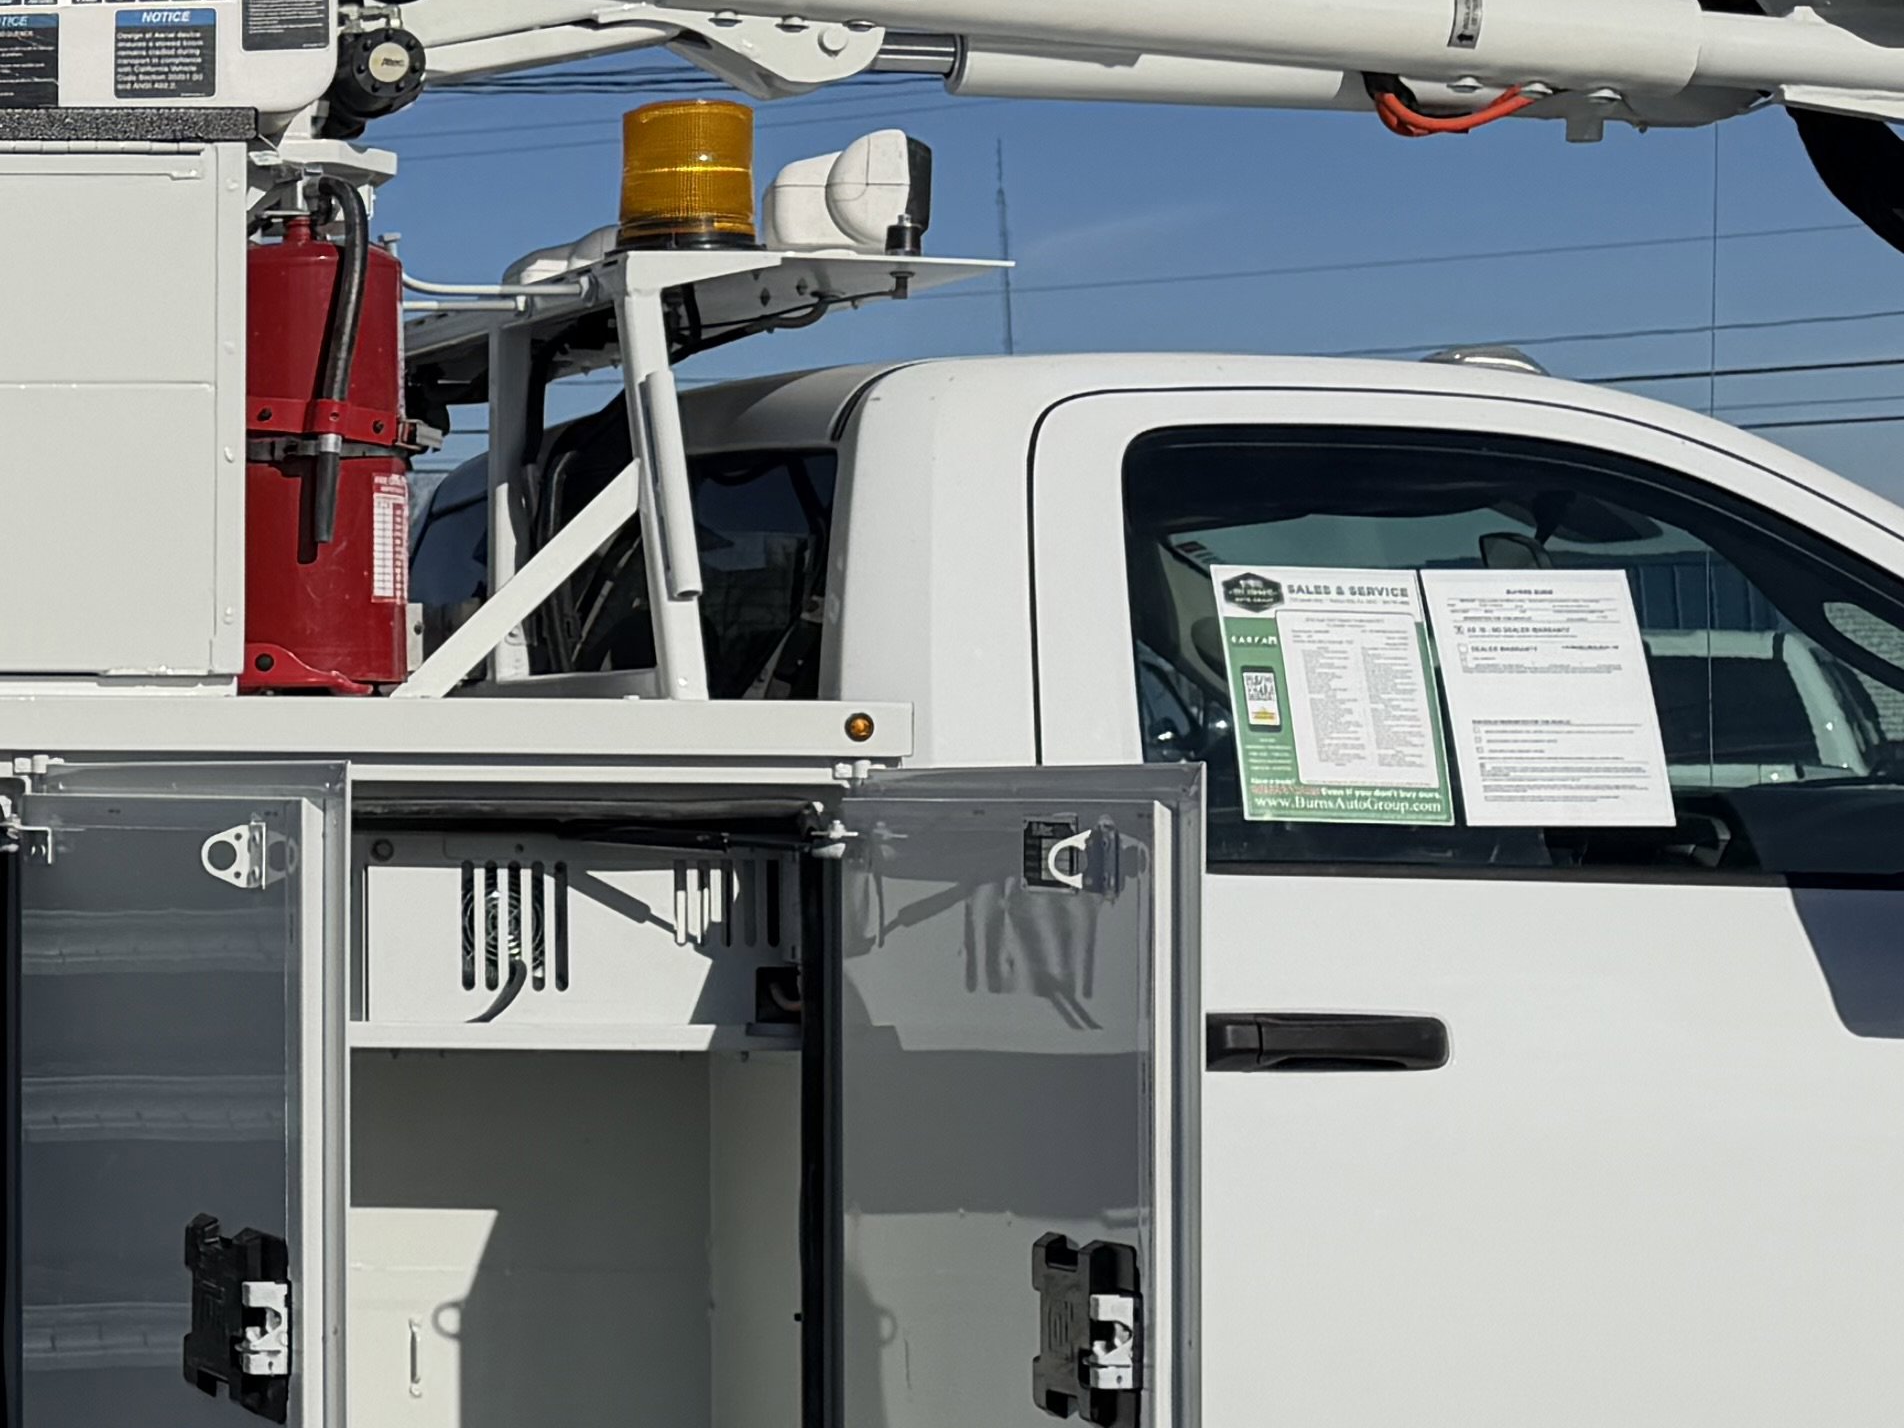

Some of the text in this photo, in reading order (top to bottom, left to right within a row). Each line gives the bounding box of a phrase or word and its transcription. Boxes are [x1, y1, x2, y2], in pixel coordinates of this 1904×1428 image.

[142, 11, 191, 23] NOTICE
[1287, 584, 1408, 597] SALES & SERVICE
[1321, 788, 1342, 796] Even
[1354, 790, 1372, 798] you
[1255, 795, 1441, 813] www.BurnsAutoGroup.com
